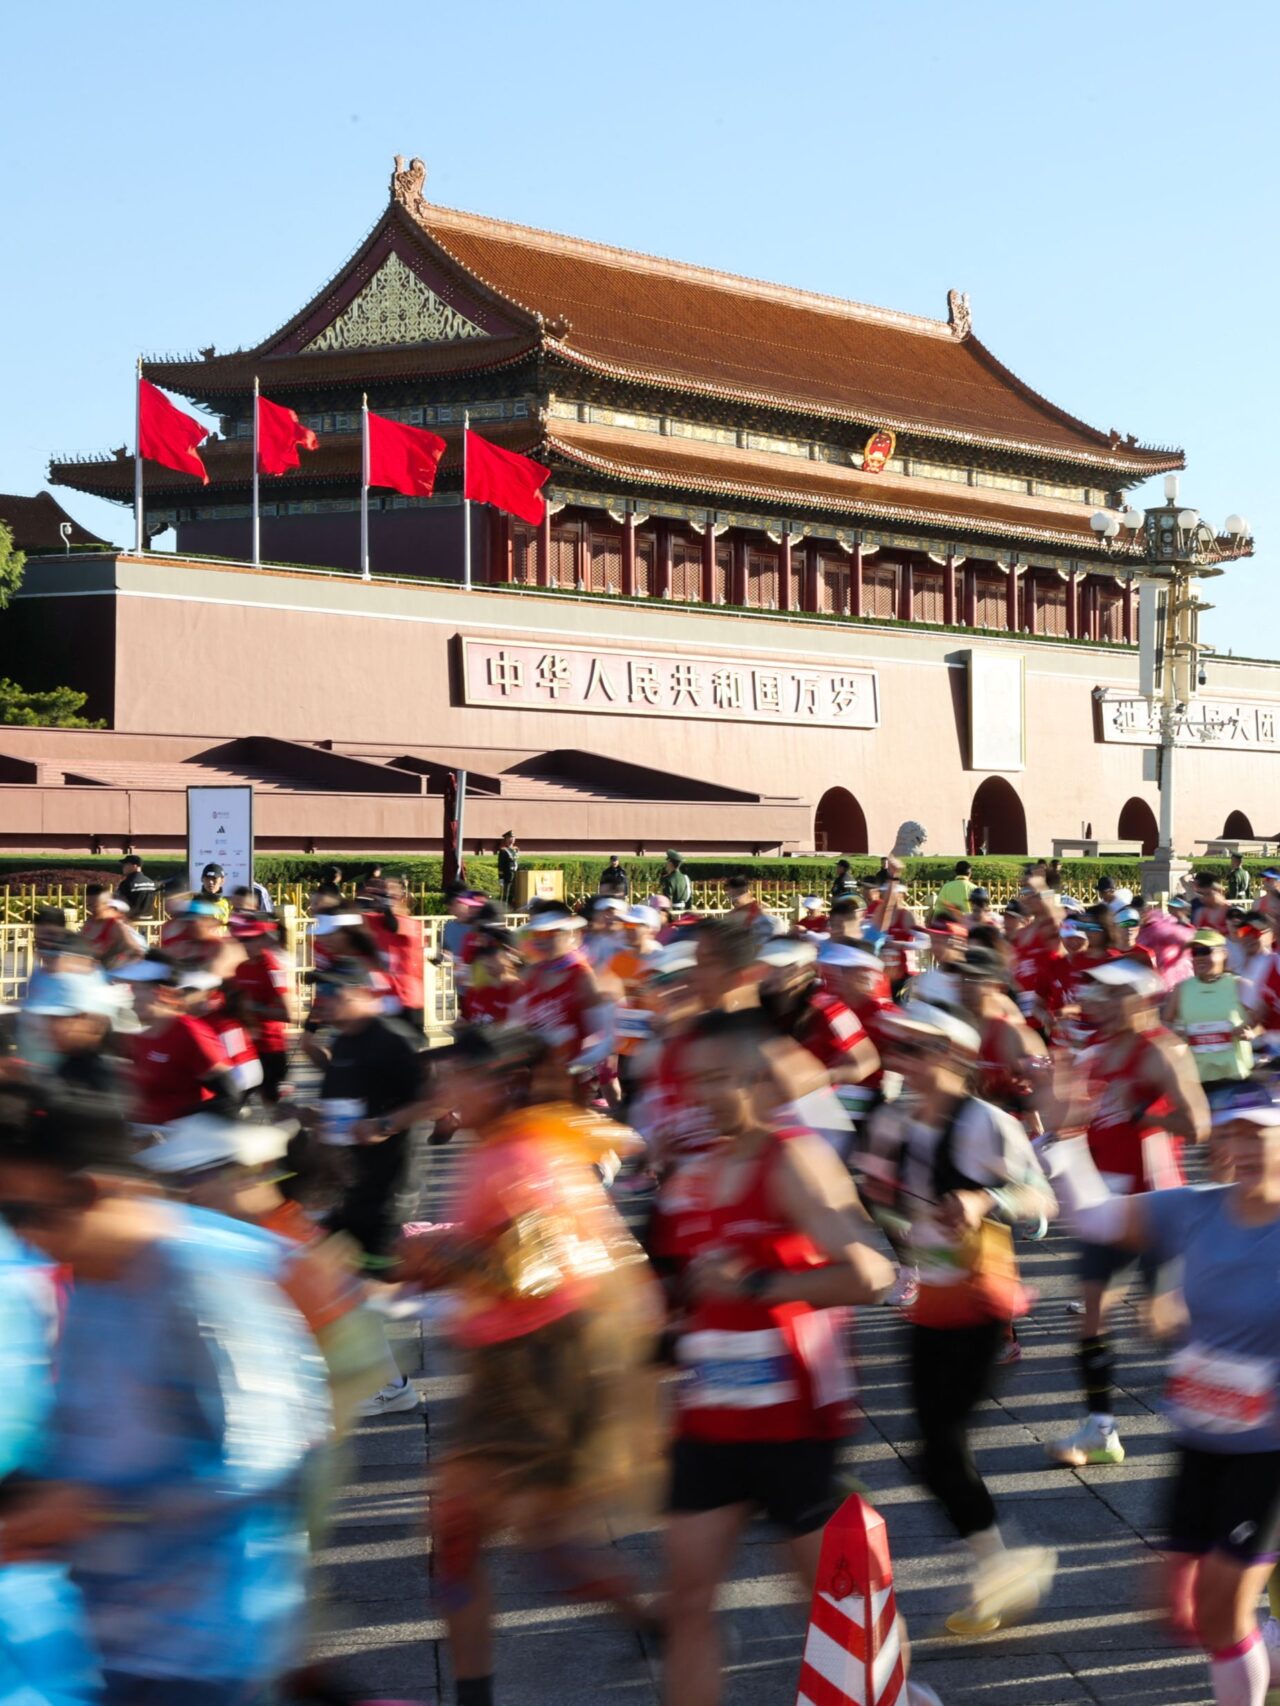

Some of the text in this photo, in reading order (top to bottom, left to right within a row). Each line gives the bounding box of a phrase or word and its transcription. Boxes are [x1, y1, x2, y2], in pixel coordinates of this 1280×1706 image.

[487, 651, 862, 717] 中华人民共和国万岁
